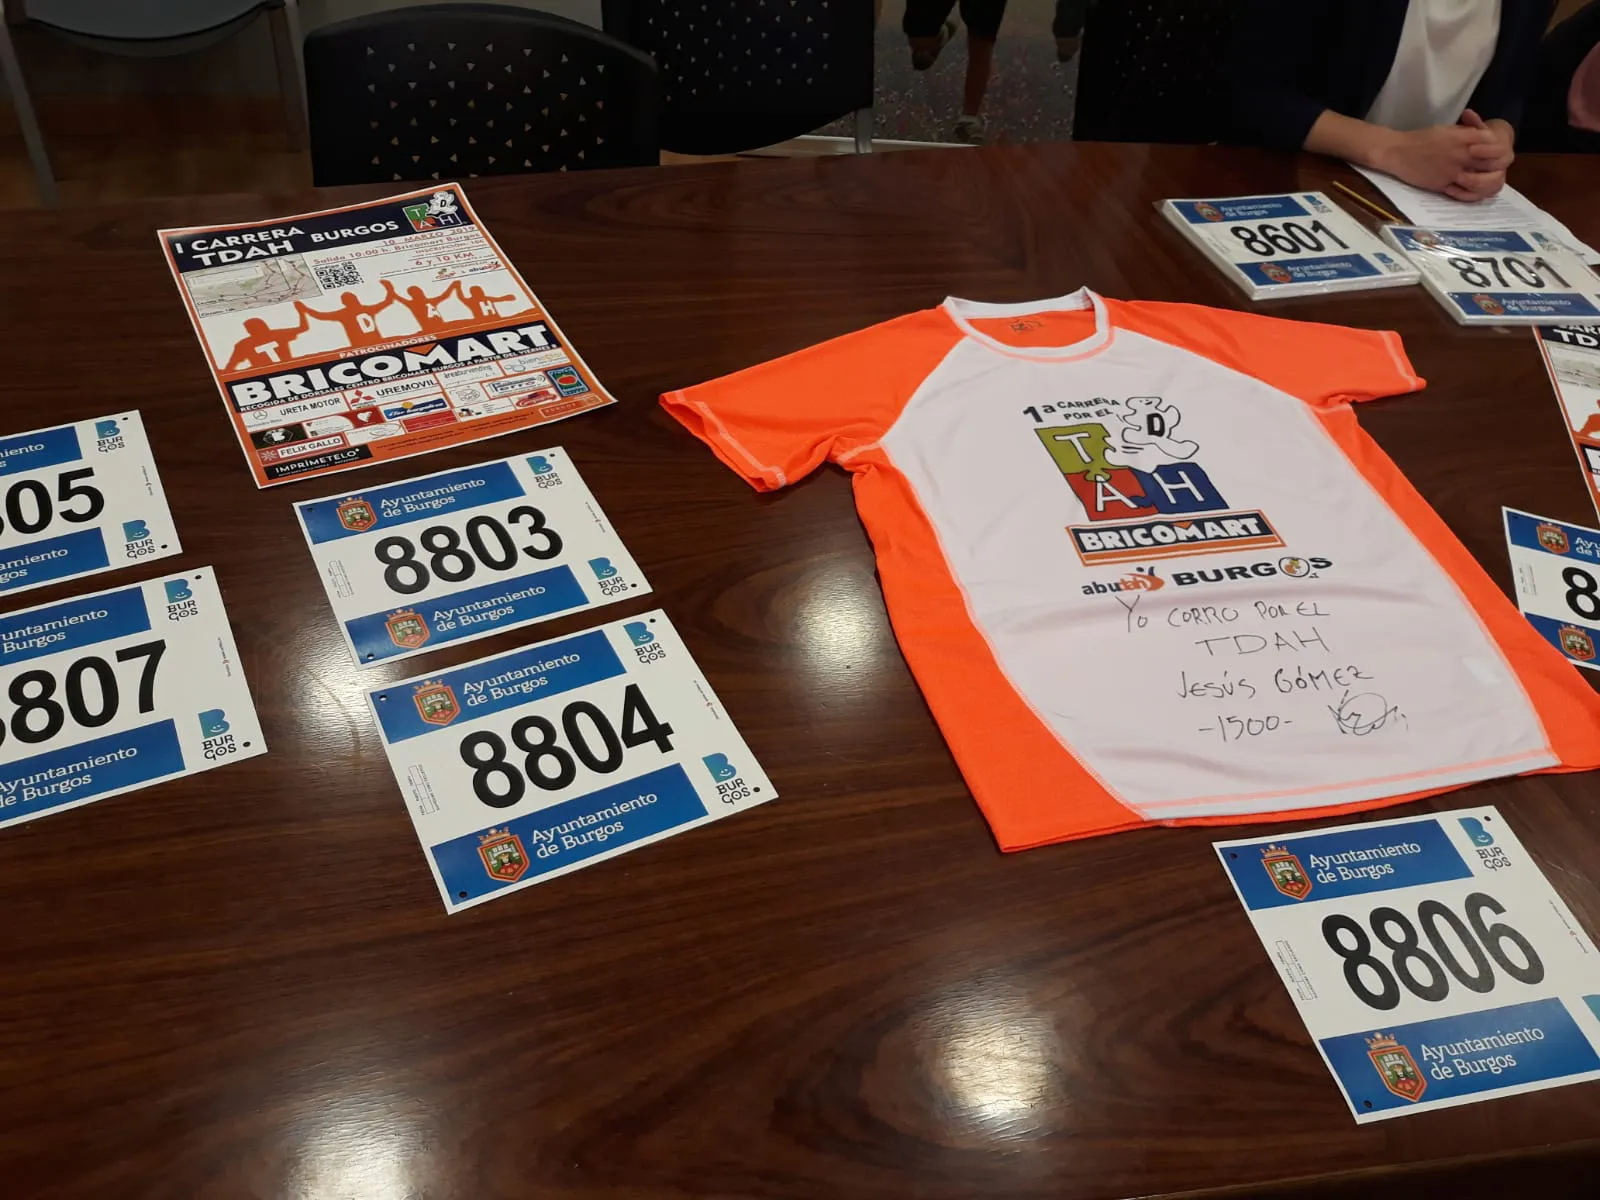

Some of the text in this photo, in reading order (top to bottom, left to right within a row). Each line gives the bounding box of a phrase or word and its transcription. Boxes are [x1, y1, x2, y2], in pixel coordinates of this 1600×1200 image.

[191, 226, 305, 251] CARRERA
[310, 220, 400, 242] BURGOS
[1230, 220, 1350, 256] 8601
[192, 240, 294, 266] TDAH
[1449, 256, 1572, 288] 8701
[254, 341, 280, 362] T
[356, 312, 376, 334] D
[479, 300, 497, 316] H
[339, 334, 438, 359] PATROCINADORES
[232, 324, 548, 407] BRICOMART
[240, 398, 288, 412] RECOGIDA
[301, 386, 344, 400] DORSALES
[376, 379, 436, 396] UREMOVIL
[280, 404, 308, 416] URETA
[310, 397, 340, 409] MOTOR
[1056, 397, 1120, 409] CARRERA
[1063, 408, 1114, 420] POR EL
[96, 436, 124, 446] BUR
[96, 442, 126, 452] GOS
[280, 438, 340, 456] FELIX GALLO
[1053, 413, 1165, 464] T D
[534, 472, 559, 484] BUR
[537, 478, 562, 489] GOS
[0, 467, 104, 536] 05
[380, 478, 486, 510] Ayuntamiento
[1094, 471, 1204, 512] A H
[382, 494, 456, 518] de Burgos
[125, 538, 153, 550] BUR
[1078, 516, 1260, 552] BRICOMART
[126, 546, 156, 559] GOS
[374, 505, 564, 595] 8803
[598, 576, 624, 590] BUR
[601, 583, 628, 597] GOS
[1562, 567, 1600, 620] 8
[166, 600, 196, 614] BUR
[168, 608, 199, 621] GOS
[432, 584, 546, 622] Ayuntamiento
[436, 604, 515, 632] de Burgos
[3, 632, 66, 654] Burgos
[634, 642, 662, 656] BUR
[1195, 626, 1330, 656] TDAH
[638, 650, 667, 665] GOS
[462, 650, 580, 696] Ayuntamiento
[0, 639, 166, 744] 807
[466, 675, 549, 706] de Burgos
[202, 734, 234, 750] BUR
[203, 742, 237, 760] GOS
[459, 683, 674, 809] 8804
[22, 774, 92, 801] Burgos
[716, 778, 746, 796] BUR
[720, 786, 751, 806] GOS
[531, 791, 658, 846] Ayuntamiento
[536, 820, 624, 860] de Burgos
[1308, 841, 1422, 870] Ayuntamiento
[1476, 846, 1506, 860] BUR
[1483, 856, 1512, 872] GOS
[1316, 860, 1395, 885] de Burgos
[1321, 892, 1545, 1012] 8806
[1420, 1024, 1546, 1064] Ayuntamiento
[1430, 1051, 1518, 1082] de Burgos
